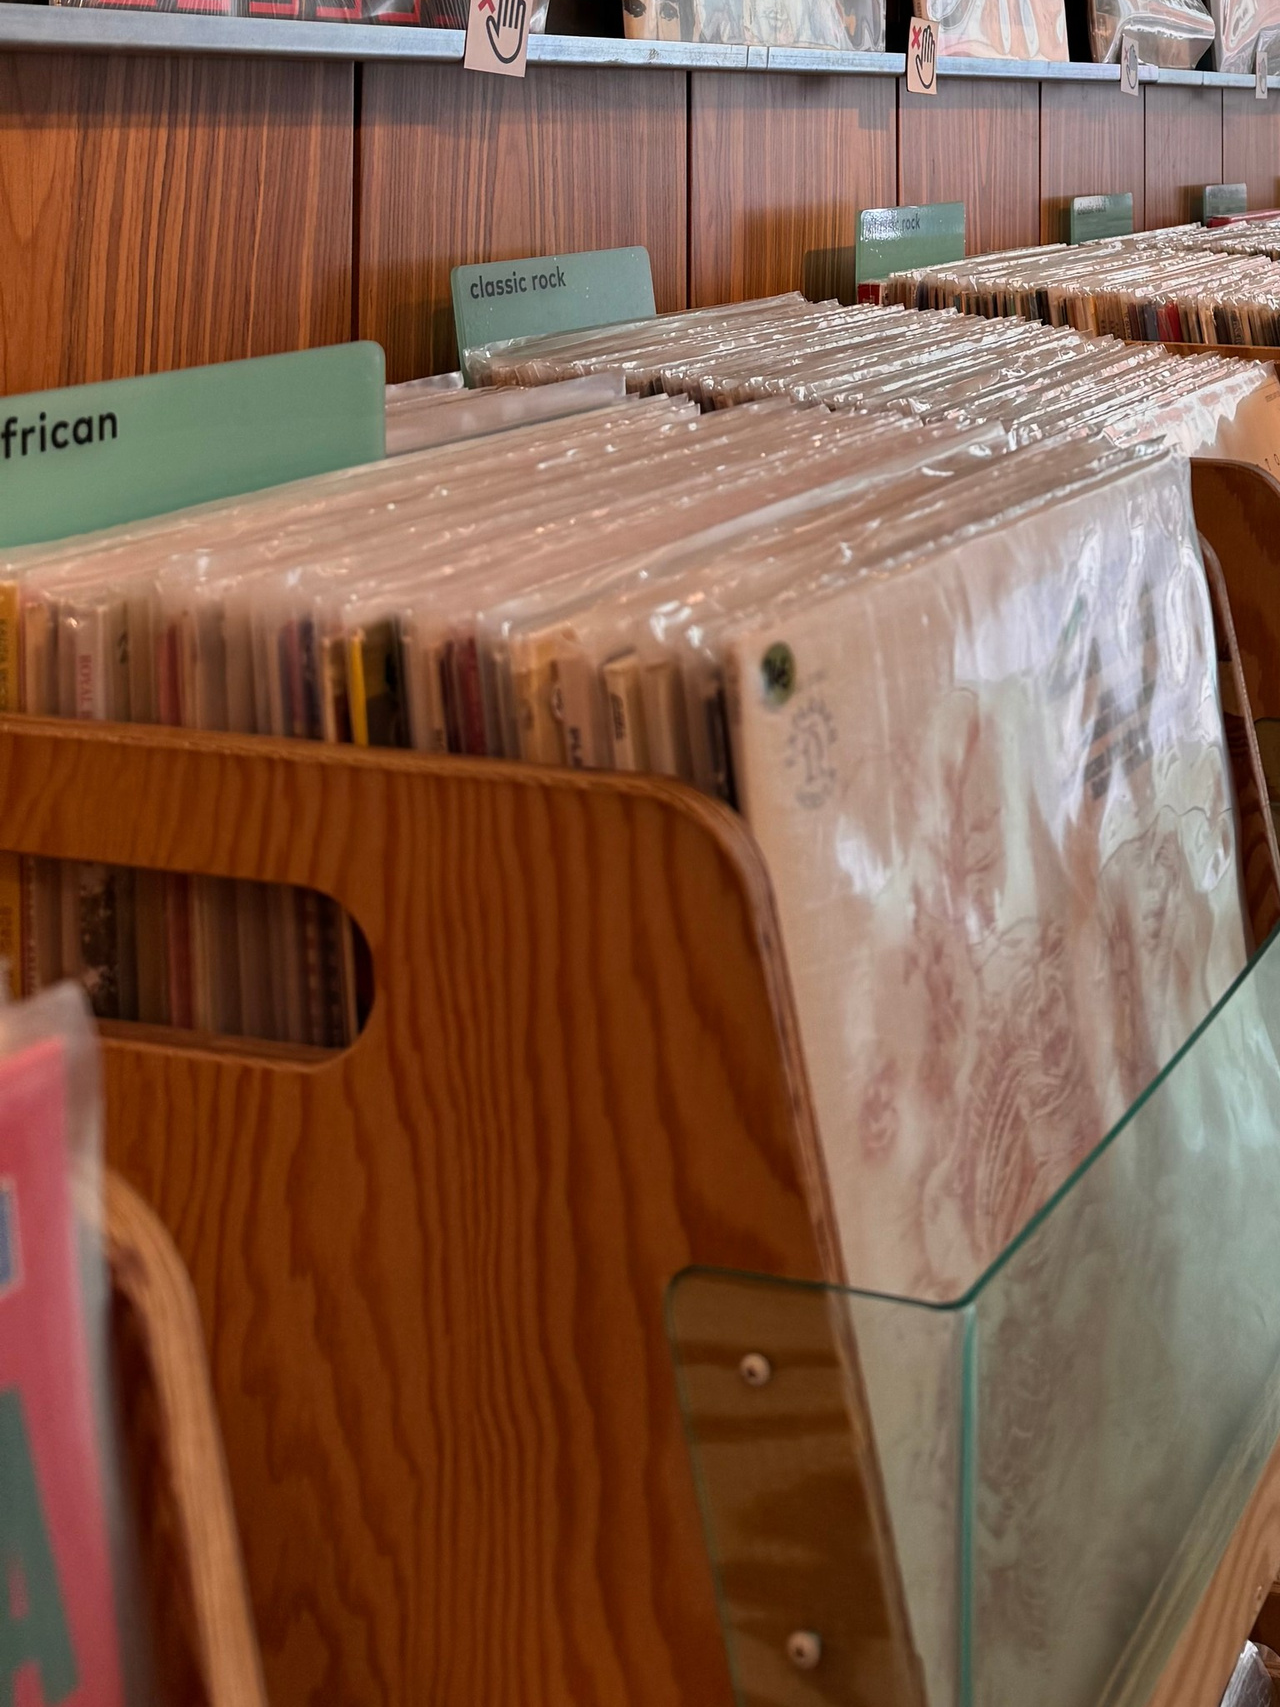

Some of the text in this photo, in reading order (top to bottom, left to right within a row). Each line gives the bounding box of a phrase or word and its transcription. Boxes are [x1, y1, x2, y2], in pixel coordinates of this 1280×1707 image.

[902, 213, 921, 230] rock
[470, 265, 567, 299] classic rock
